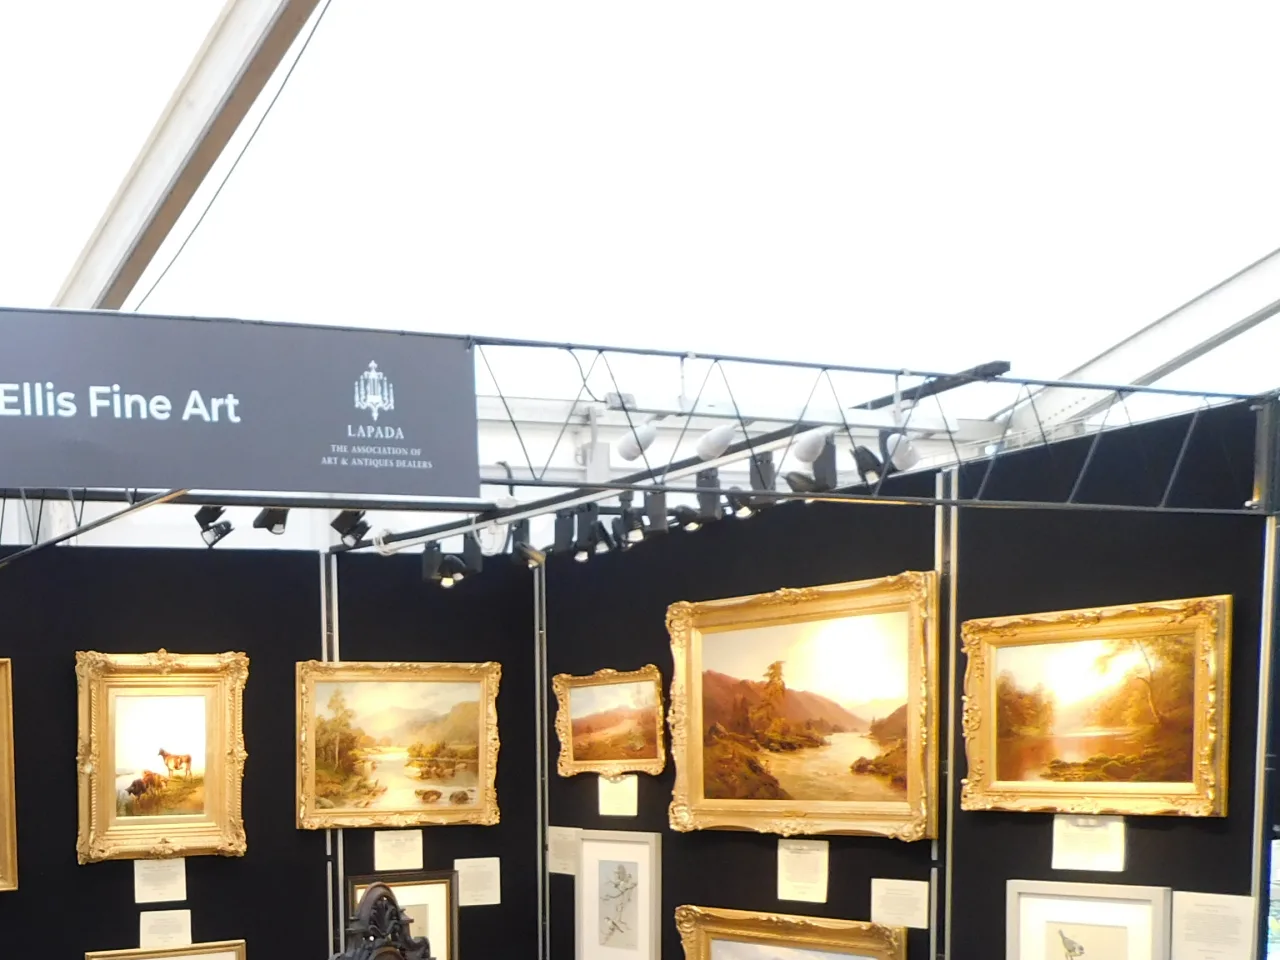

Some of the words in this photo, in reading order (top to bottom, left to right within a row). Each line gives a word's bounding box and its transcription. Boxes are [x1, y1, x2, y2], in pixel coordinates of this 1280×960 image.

[88, 383, 172, 421] Fine
[181, 389, 241, 423] Art
[347, 424, 405, 440] LAPADA
[330, 444, 349, 453] THE
[351, 445, 409, 456] ASSOCIATION
[410, 448, 422, 456] OF
[321, 456, 338, 465] ART
[340, 457, 349, 466] &
[351, 457, 394, 468] ANTIQUES
[395, 460, 433, 469] DEALERS
